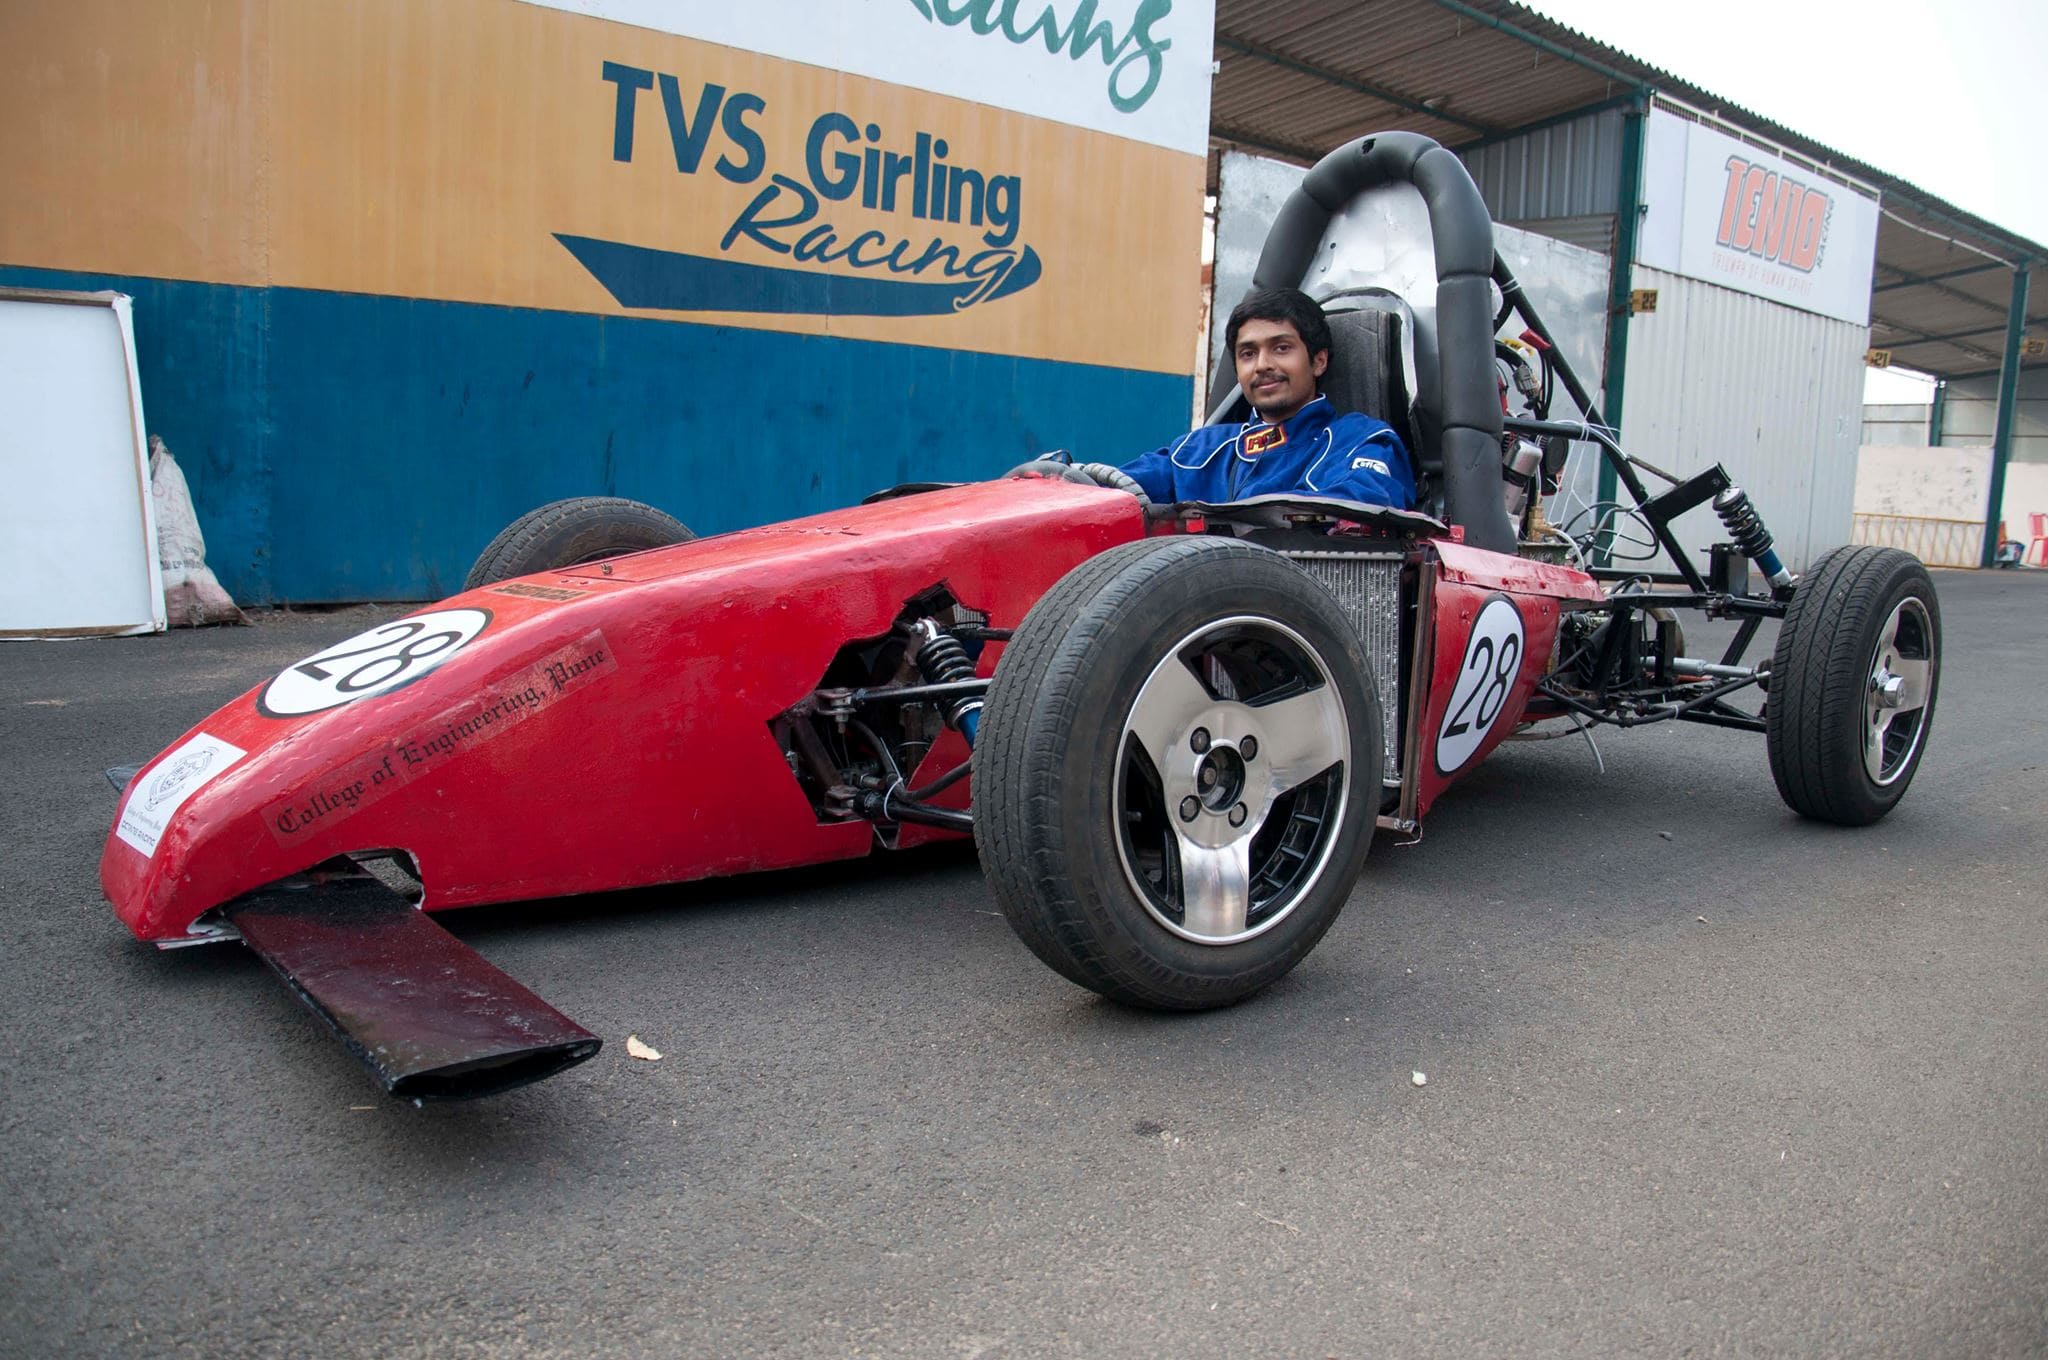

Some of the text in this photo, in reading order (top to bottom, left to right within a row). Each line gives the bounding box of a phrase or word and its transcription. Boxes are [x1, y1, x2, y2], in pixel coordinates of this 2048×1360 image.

[602, 60, 1021, 248] TVS Girling
[720, 173, 1018, 308] Racing
[1641, 292, 1657, 310] 22
[1872, 351, 1888, 368] 21
[294, 622, 463, 692] 28
[1442, 632, 1519, 739] 28
[276, 649, 606, 834] College of Engineering, Pune
